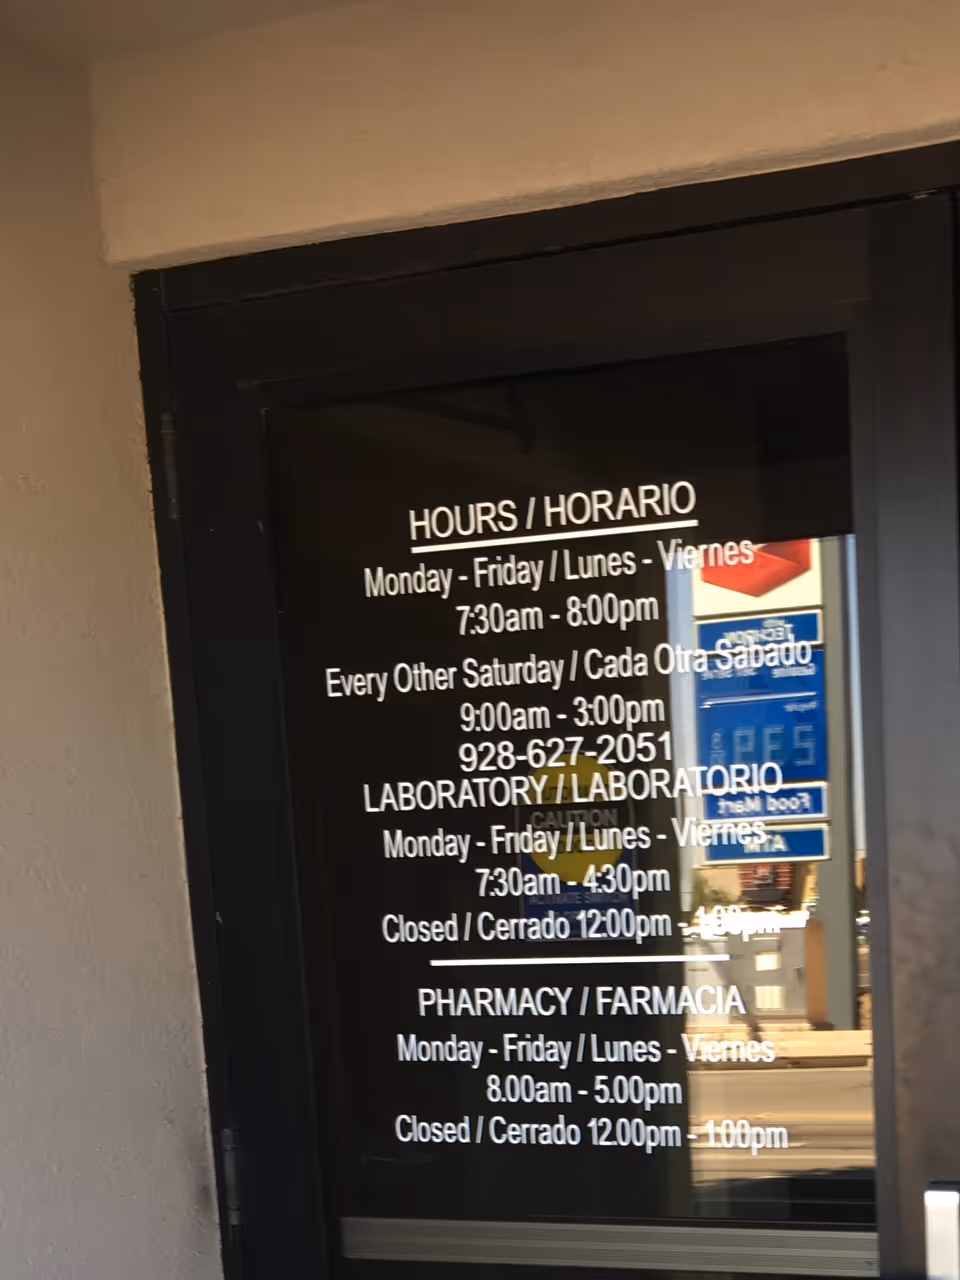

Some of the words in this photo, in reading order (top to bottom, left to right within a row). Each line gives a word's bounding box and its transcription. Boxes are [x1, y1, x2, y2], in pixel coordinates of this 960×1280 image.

[409, 499, 518, 541] HOURS
[544, 481, 697, 527] HORARIO
[364, 564, 453, 599] Monday
[473, 555, 544, 591] Friday
[563, 549, 637, 581] Lunes
[657, 538, 754, 572] Viernes
[456, 603, 544, 636] 7:30am
[566, 595, 659, 634] 8:00pm
[326, 668, 388, 702] Every
[393, 663, 456, 693] Other
[463, 654, 564, 691] Saturday
[584, 646, 646, 681] Cada
[653, 643, 707, 675] Otra
[714, 637, 812, 669] Sabado
[460, 702, 551, 733] 9:00am
[573, 696, 664, 735] 3:00pm
[458, 731, 672, 772] 928-627-2051
[364, 774, 549, 812] LABORATORY
[573, 762, 783, 803] LABORATORIO
[531, 808, 618, 829] CAUTION
[383, 828, 471, 863] Monday
[491, 823, 560, 862] Friday
[580, 821, 651, 853] Lunes
[671, 818, 766, 848] Viernes
[475, 868, 560, 898] 7:30am
[583, 864, 670, 902] 4:30pm
[382, 913, 458, 943] Closed
[477, 909, 570, 940] Cerrado
[579, 908, 672, 944] 12:00pm
[418, 987, 572, 1016] PHARMACY
[598, 985, 746, 1015] FARMACIA
[397, 1033, 483, 1069] Monday
[504, 1033, 569, 1069] Friday
[592, 1033, 661, 1064] Lunes
[681, 1032, 776, 1064] Viernes
[395, 1115, 470, 1144] Closed
[489, 1115, 581, 1145] Cerrado
